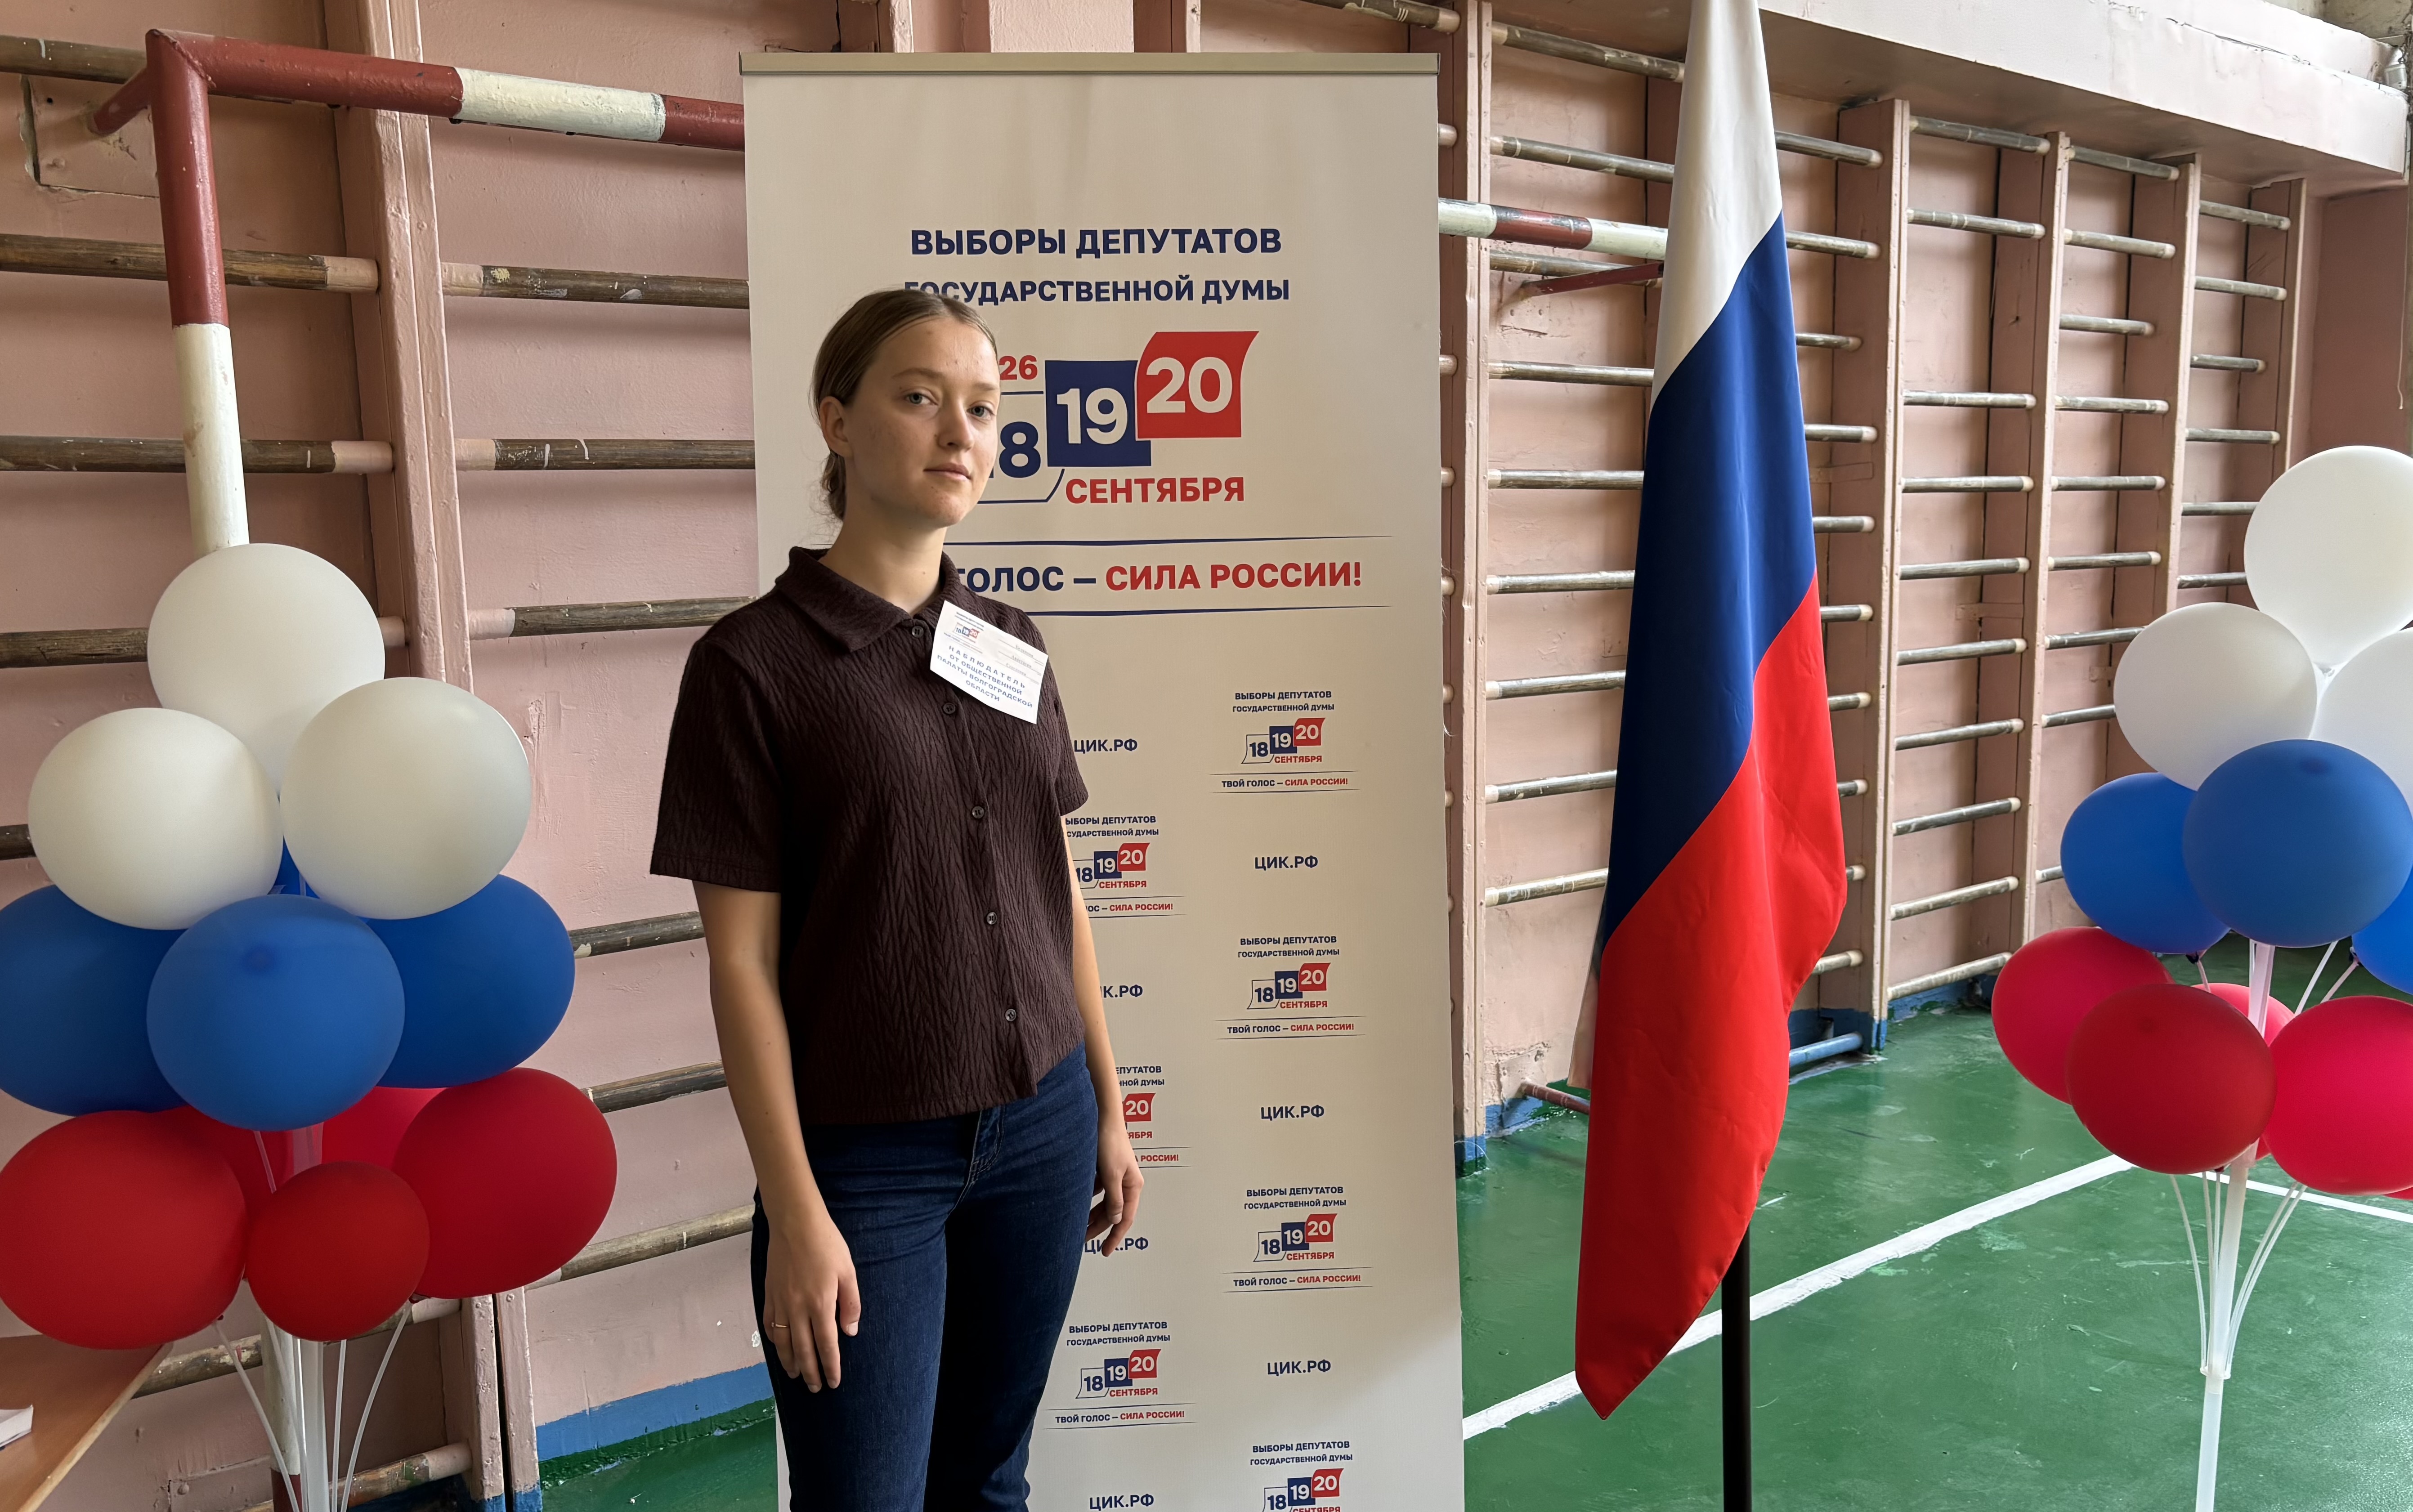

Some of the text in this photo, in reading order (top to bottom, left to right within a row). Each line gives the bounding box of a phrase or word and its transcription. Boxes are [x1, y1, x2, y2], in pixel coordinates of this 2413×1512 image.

[912, 228, 1281, 259] ВЫБОРЫ ДЕПУТАТОВ
[1202, 280, 1289, 304] ДУМЫ
[999, 354, 1038, 381] 26
[989, 357, 1232, 479] 8 19 20
[1066, 477, 1244, 504] СЕНТЯБРЯ
[958, 566, 1064, 593] ОЛОС
[1106, 565, 1200, 590] СИЛА
[1211, 562, 1361, 588] РОССИИ!
[949, 645, 1025, 688] НАБЛЮДАТЕЛЬ
[937, 655, 1033, 708] ПАЛАТЫ ВОЛГОГРАДСКОЙ
[961, 661, 1022, 695] ОБЩЕСТВЕННОЙ
[966, 680, 999, 701] ОБЛАСТИ
[1278, 691, 1331, 700] ДЕПУТАТОВ
[1233, 703, 1309, 712] ГОСУДАРСТВЕННОЙ
[1074, 739, 1137, 754] ЦИК.РФ
[1249, 725, 1318, 757] 18 19 20
[1222, 779, 1244, 787] ТВОЙ
[1102, 816, 1156, 825] ДЕПУТАТОВ
[1067, 828, 1133, 837] СУДАРСТВЕННОЙ
[1097, 858, 1115, 872] 19
[1120, 850, 1143, 864] 20
[1255, 855, 1318, 871] ЦИК.РФ
[1283, 936, 1336, 945] ДЕПУТАТОВ
[1238, 948, 1314, 957] ГОСУДАРСТВЕННОЙ
[1101, 984, 1143, 998] К.РФ
[1255, 970, 1324, 1002] 18 19 20
[1227, 1025, 1250, 1033] ТВОЙ
[1126, 1100, 1148, 1115] 20
[1261, 1105, 1324, 1121] ЦИК.РФ
[1247, 1187, 1343, 1196] ВЫБОРЫ ДЕПУТАТОВ
[1245, 1199, 1320, 1209] ГОСУДАРСТВЕННОЙ
[1262, 1221, 1330, 1254] 18 19 20
[1085, 1237, 1148, 1254] ЦИ.РФ
[1287, 1252, 1334, 1260] СЕНТЯБРЯ
[1233, 1277, 1256, 1286] ТВОЙ
[1070, 1322, 1167, 1333] ВЫБОРЫ ДЕПУТАТОВ
[1067, 1335, 1144, 1346] ГОСУДАРСТВЕННОЙ
[1084, 1356, 1154, 1391] 18 19 20
[1268, 1360, 1330, 1376] ЦИК.РФ
[1110, 1388, 1158, 1397] СЕНТЯБРЯ
[1055, 1414, 1079, 1423] ТВОЙ
[1253, 1441, 1349, 1452] ВЫБОРЫ ДЕПУТАТОВ
[1250, 1454, 1326, 1465] ГОСУДАРСТВЕННОЙ
[1267, 1476, 1337, 1510] 18 19 20
[1090, 1494, 1154, 1511] ЦИК.РФ
